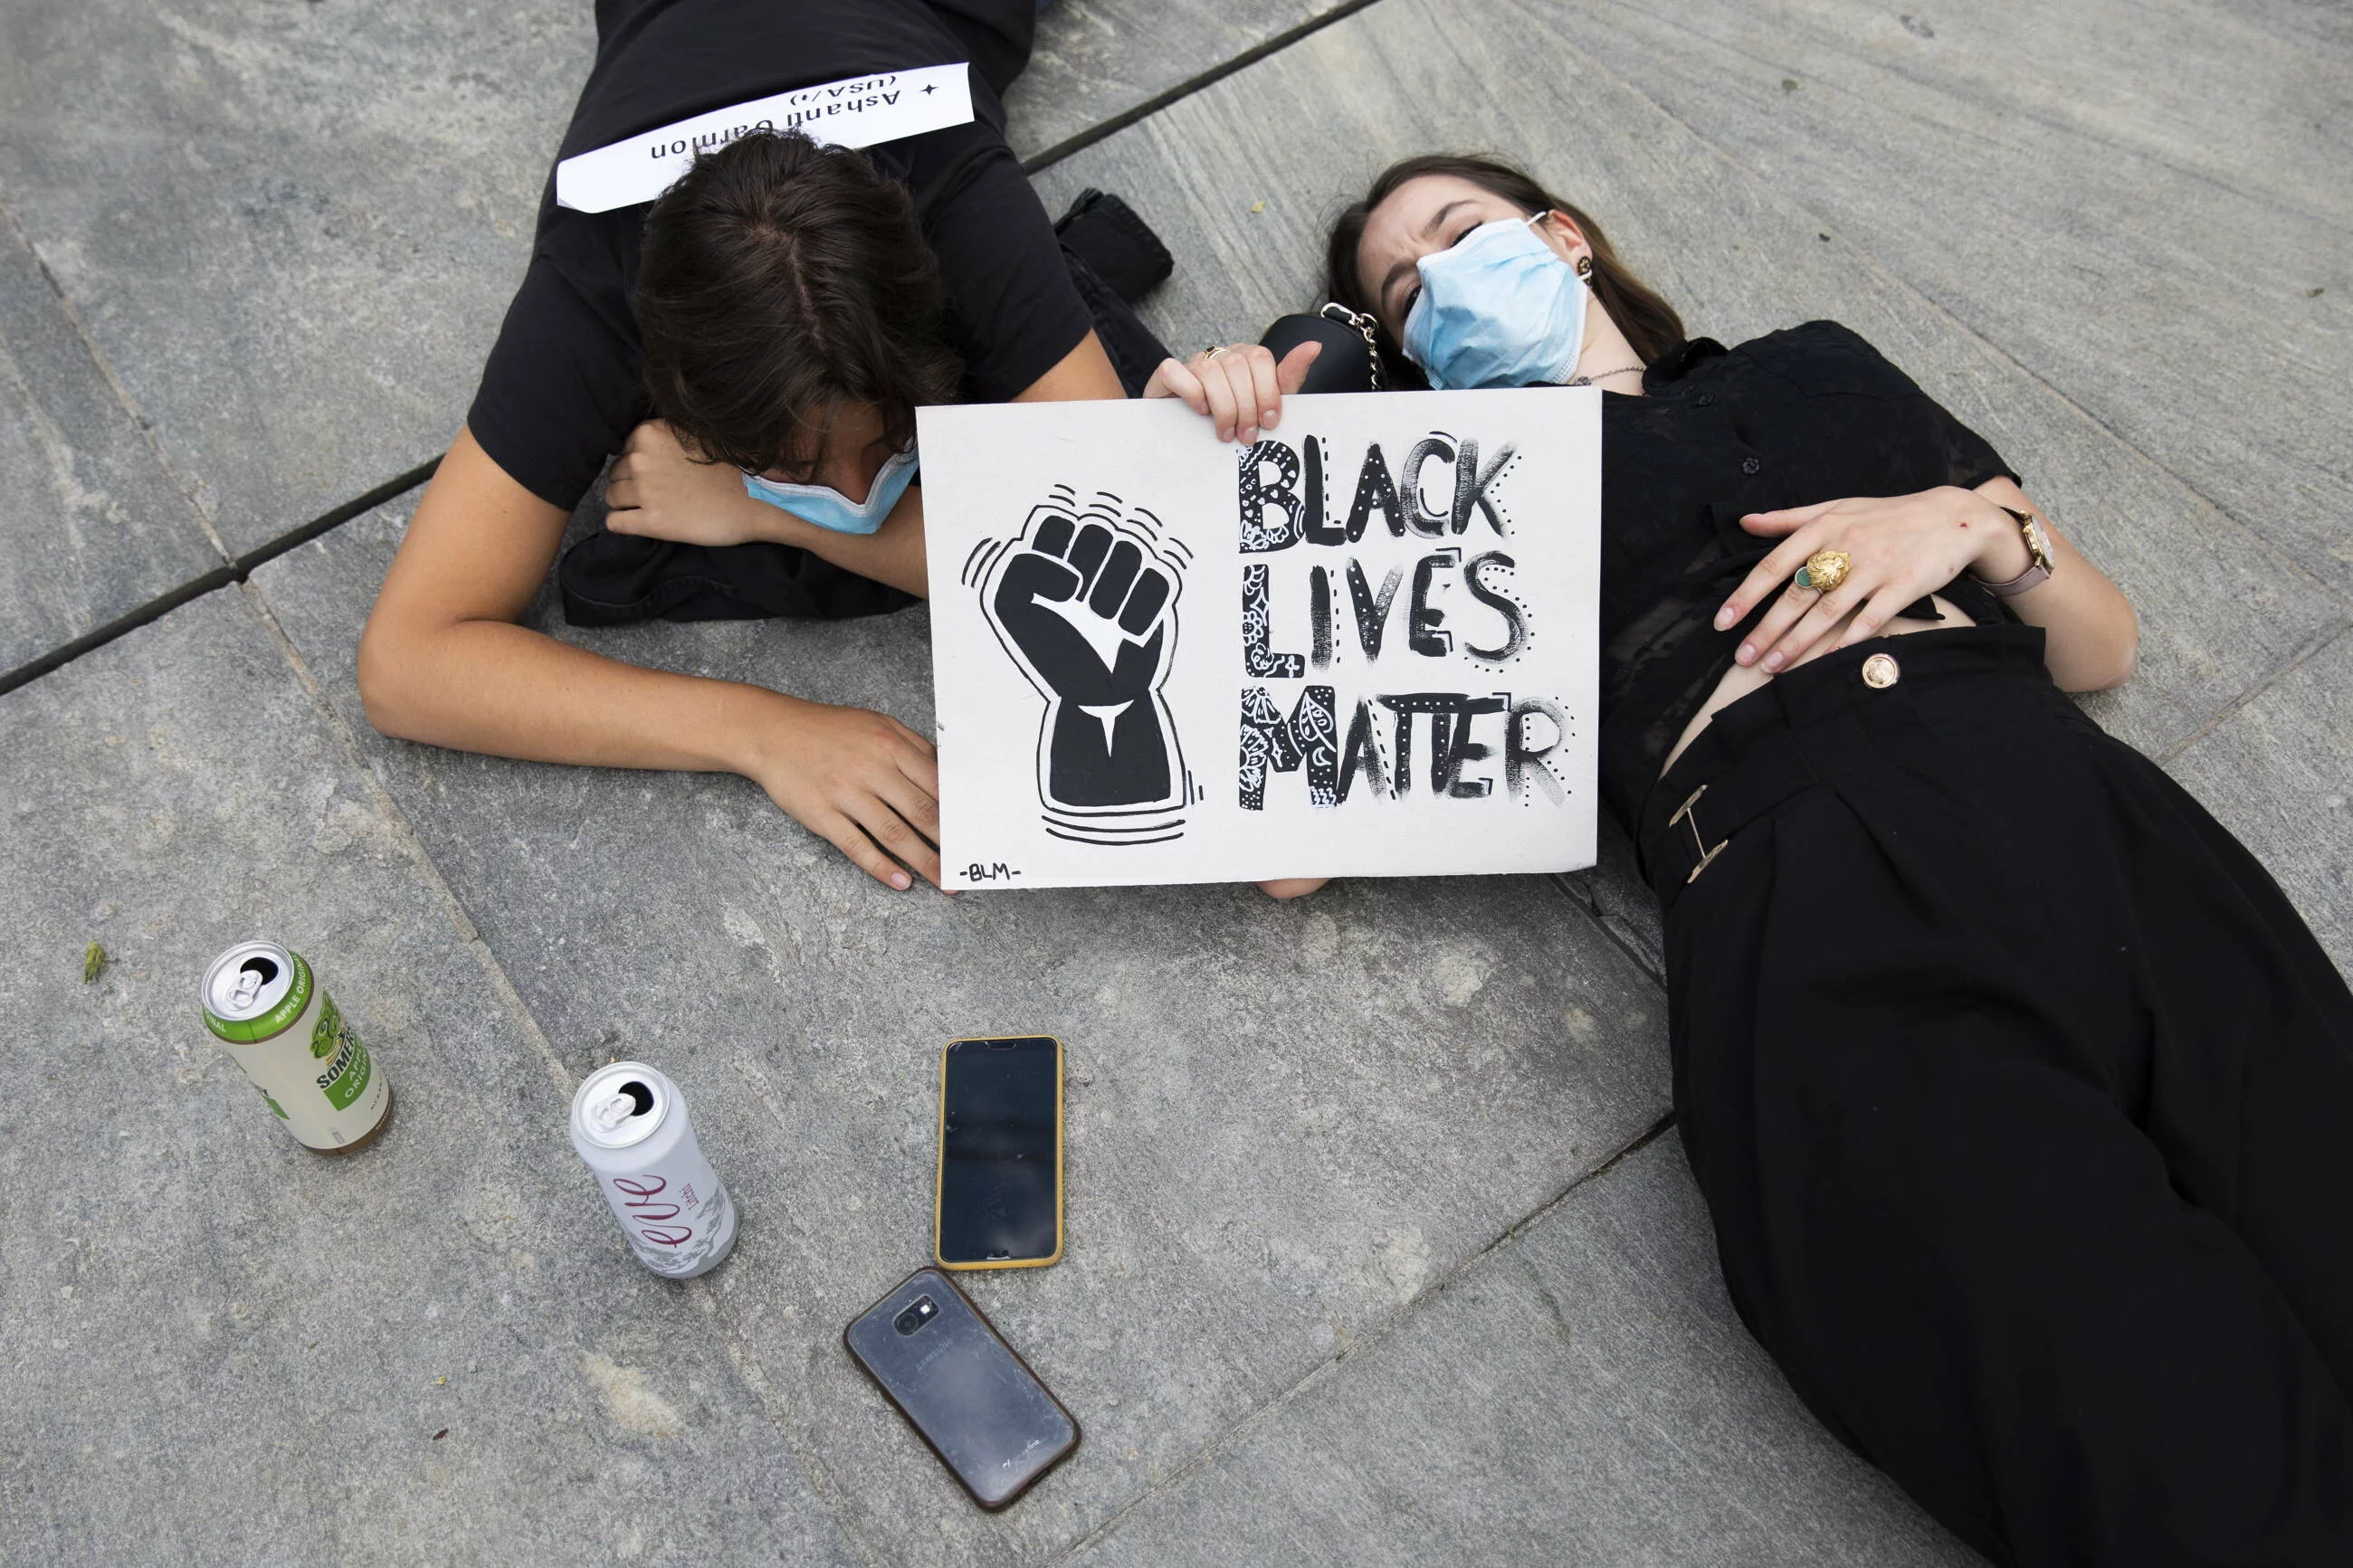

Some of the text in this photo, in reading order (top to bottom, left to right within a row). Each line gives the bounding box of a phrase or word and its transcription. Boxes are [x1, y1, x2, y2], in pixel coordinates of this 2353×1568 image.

[786, 90, 901, 129] Ashanti
[1238, 433, 1518, 554] BLACK
[1241, 548, 1529, 679] LIVES
[1238, 685, 1567, 811] MATTER
[274, 995, 300, 1024] APPLE
[316, 1025, 355, 1089] SOMER
[613, 1174, 692, 1249] eve
